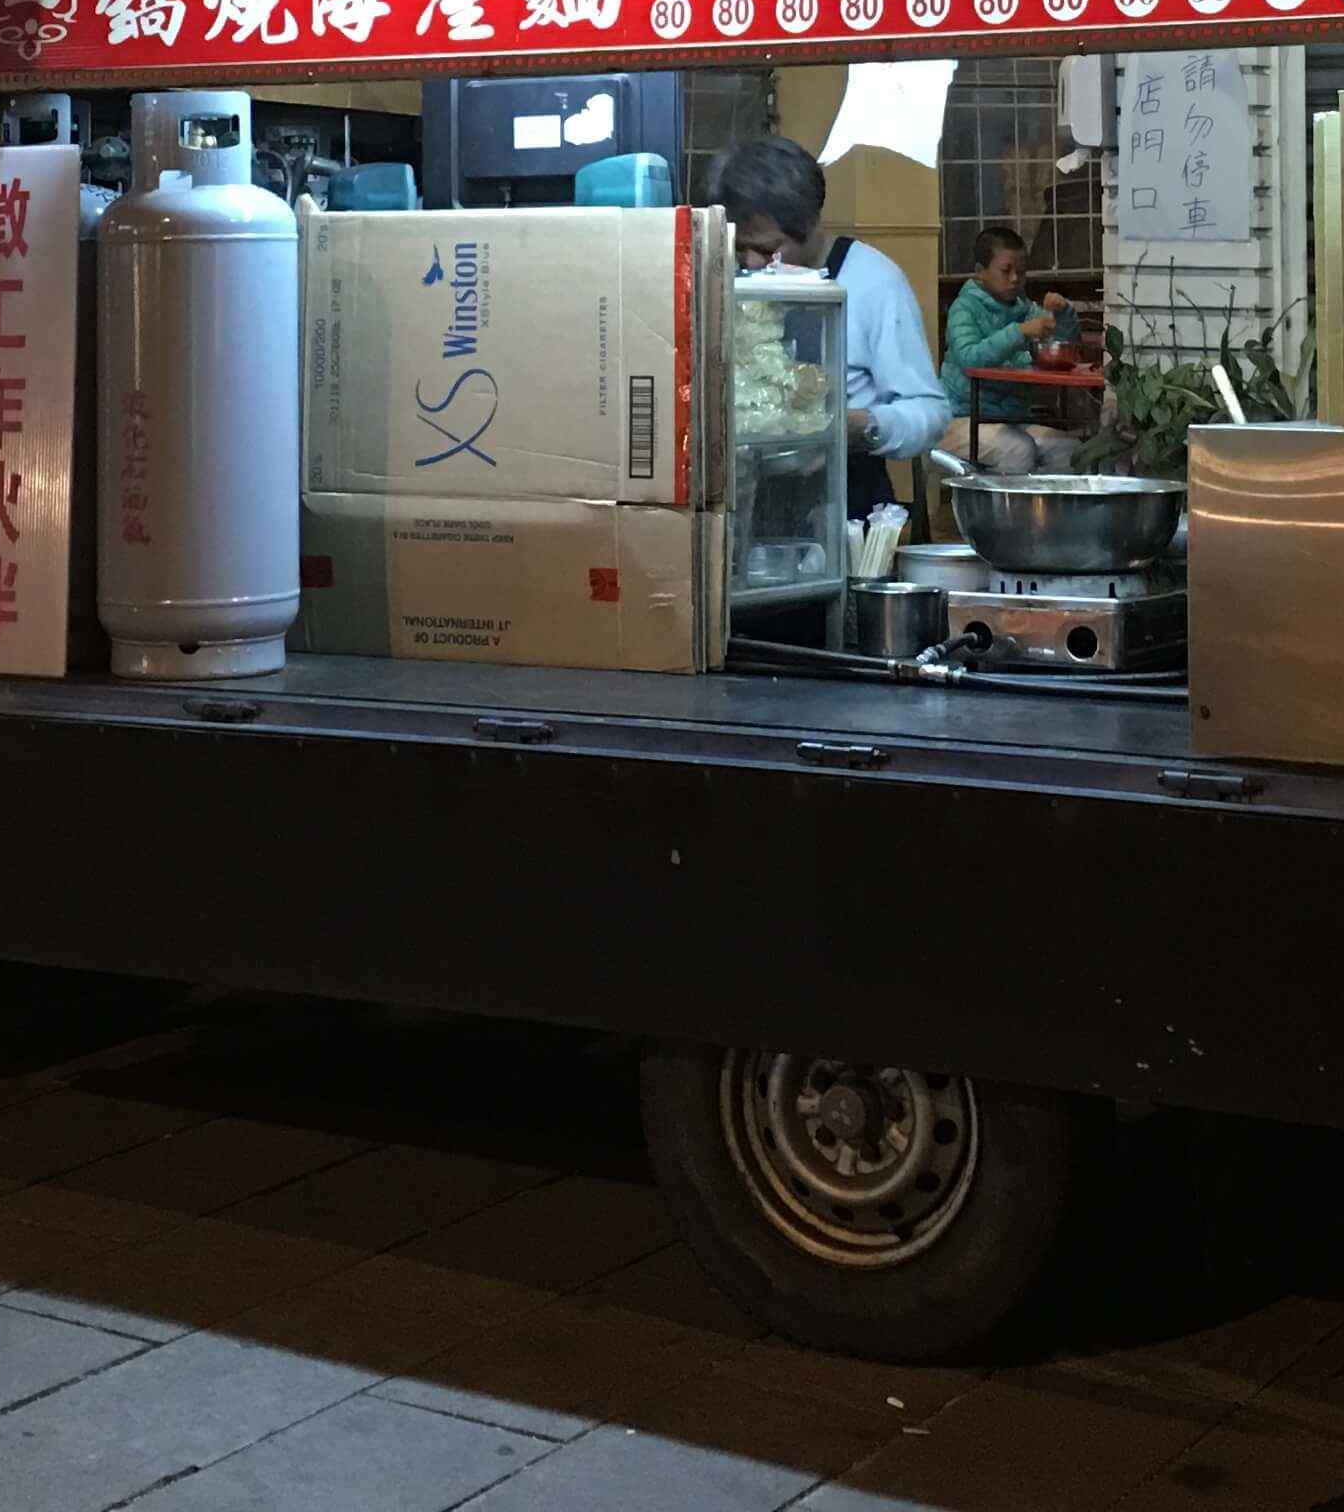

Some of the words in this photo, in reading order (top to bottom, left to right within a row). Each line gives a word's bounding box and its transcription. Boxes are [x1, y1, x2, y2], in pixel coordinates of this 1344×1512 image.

[656, 0, 686, 29] 80
[1130, 74, 1165, 210] 店門口
[1178, 55, 1217, 238] 請勿停車
[480, 242, 490, 275] Blue
[442, 243, 478, 359] Winston
[480, 278, 492, 328] XStyle
[599, 295, 608, 371] CIGARETTES
[599, 375, 607, 417] FILTER
[415, 368, 498, 467] XS
[402, 615, 496, 630] INTERNATIONAL
[413, 631, 430, 643] OF
[433, 633, 490, 646] PRODUCT
[493, 636, 501, 646] A
